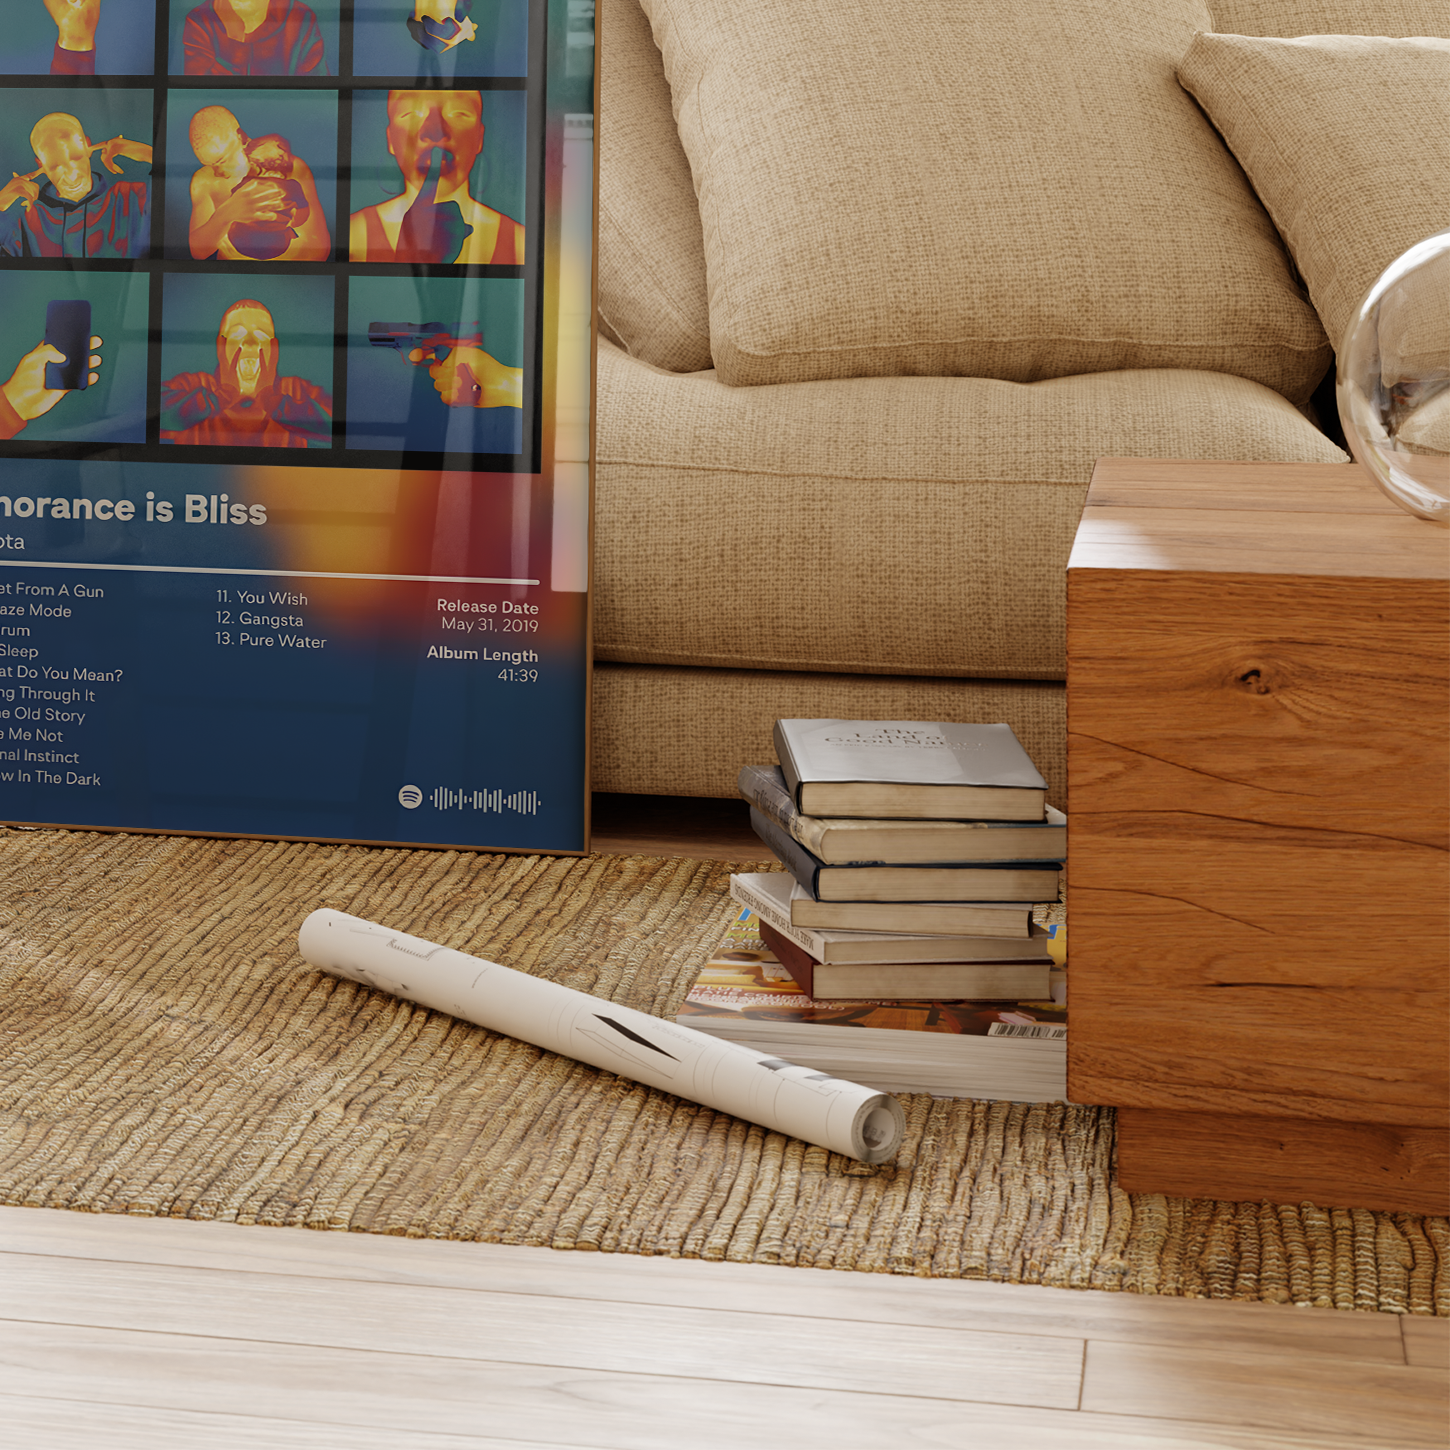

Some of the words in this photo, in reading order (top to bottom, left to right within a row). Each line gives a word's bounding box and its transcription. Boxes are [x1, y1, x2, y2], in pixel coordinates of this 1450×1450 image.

[145, 490, 174, 523] is
[184, 492, 268, 526] Bliss
[15, 581, 55, 596] From
[57, 583, 71, 597] A
[73, 583, 104, 598] Gun
[216, 589, 232, 603] 11.
[236, 590, 265, 605] You
[268, 591, 308, 606] Wish
[29, 603, 72, 618] Mode
[437, 598, 498, 614] Release
[502, 600, 539, 615] Date
[216, 610, 235, 625] 12.
[239, 611, 304, 630] Gangsta
[441, 616, 475, 634] May
[477, 617, 498, 633] 31,
[502, 618, 539, 633] 2019
[214, 631, 235, 645] 13.
[239, 632, 275, 647] Pure
[277, 633, 328, 649] Water
[426, 645, 479, 660] Album
[483, 647, 539, 666] Length
[17, 664, 39, 679] Do
[41, 665, 69, 680] You
[73, 667, 124, 683] Mean?
[497, 668, 539, 683] 41:39
[18, 685, 81, 705] Through
[85, 688, 96, 703] It
[14, 706, 41, 721] Old
[44, 707, 86, 726] Story
[8, 726, 32, 741] Me
[35, 728, 64, 743] Not
[24, 748, 80, 764] Instinct
[18, 769, 31, 783] In
[34, 769, 62, 785] The
[66, 771, 101, 786] Dark
